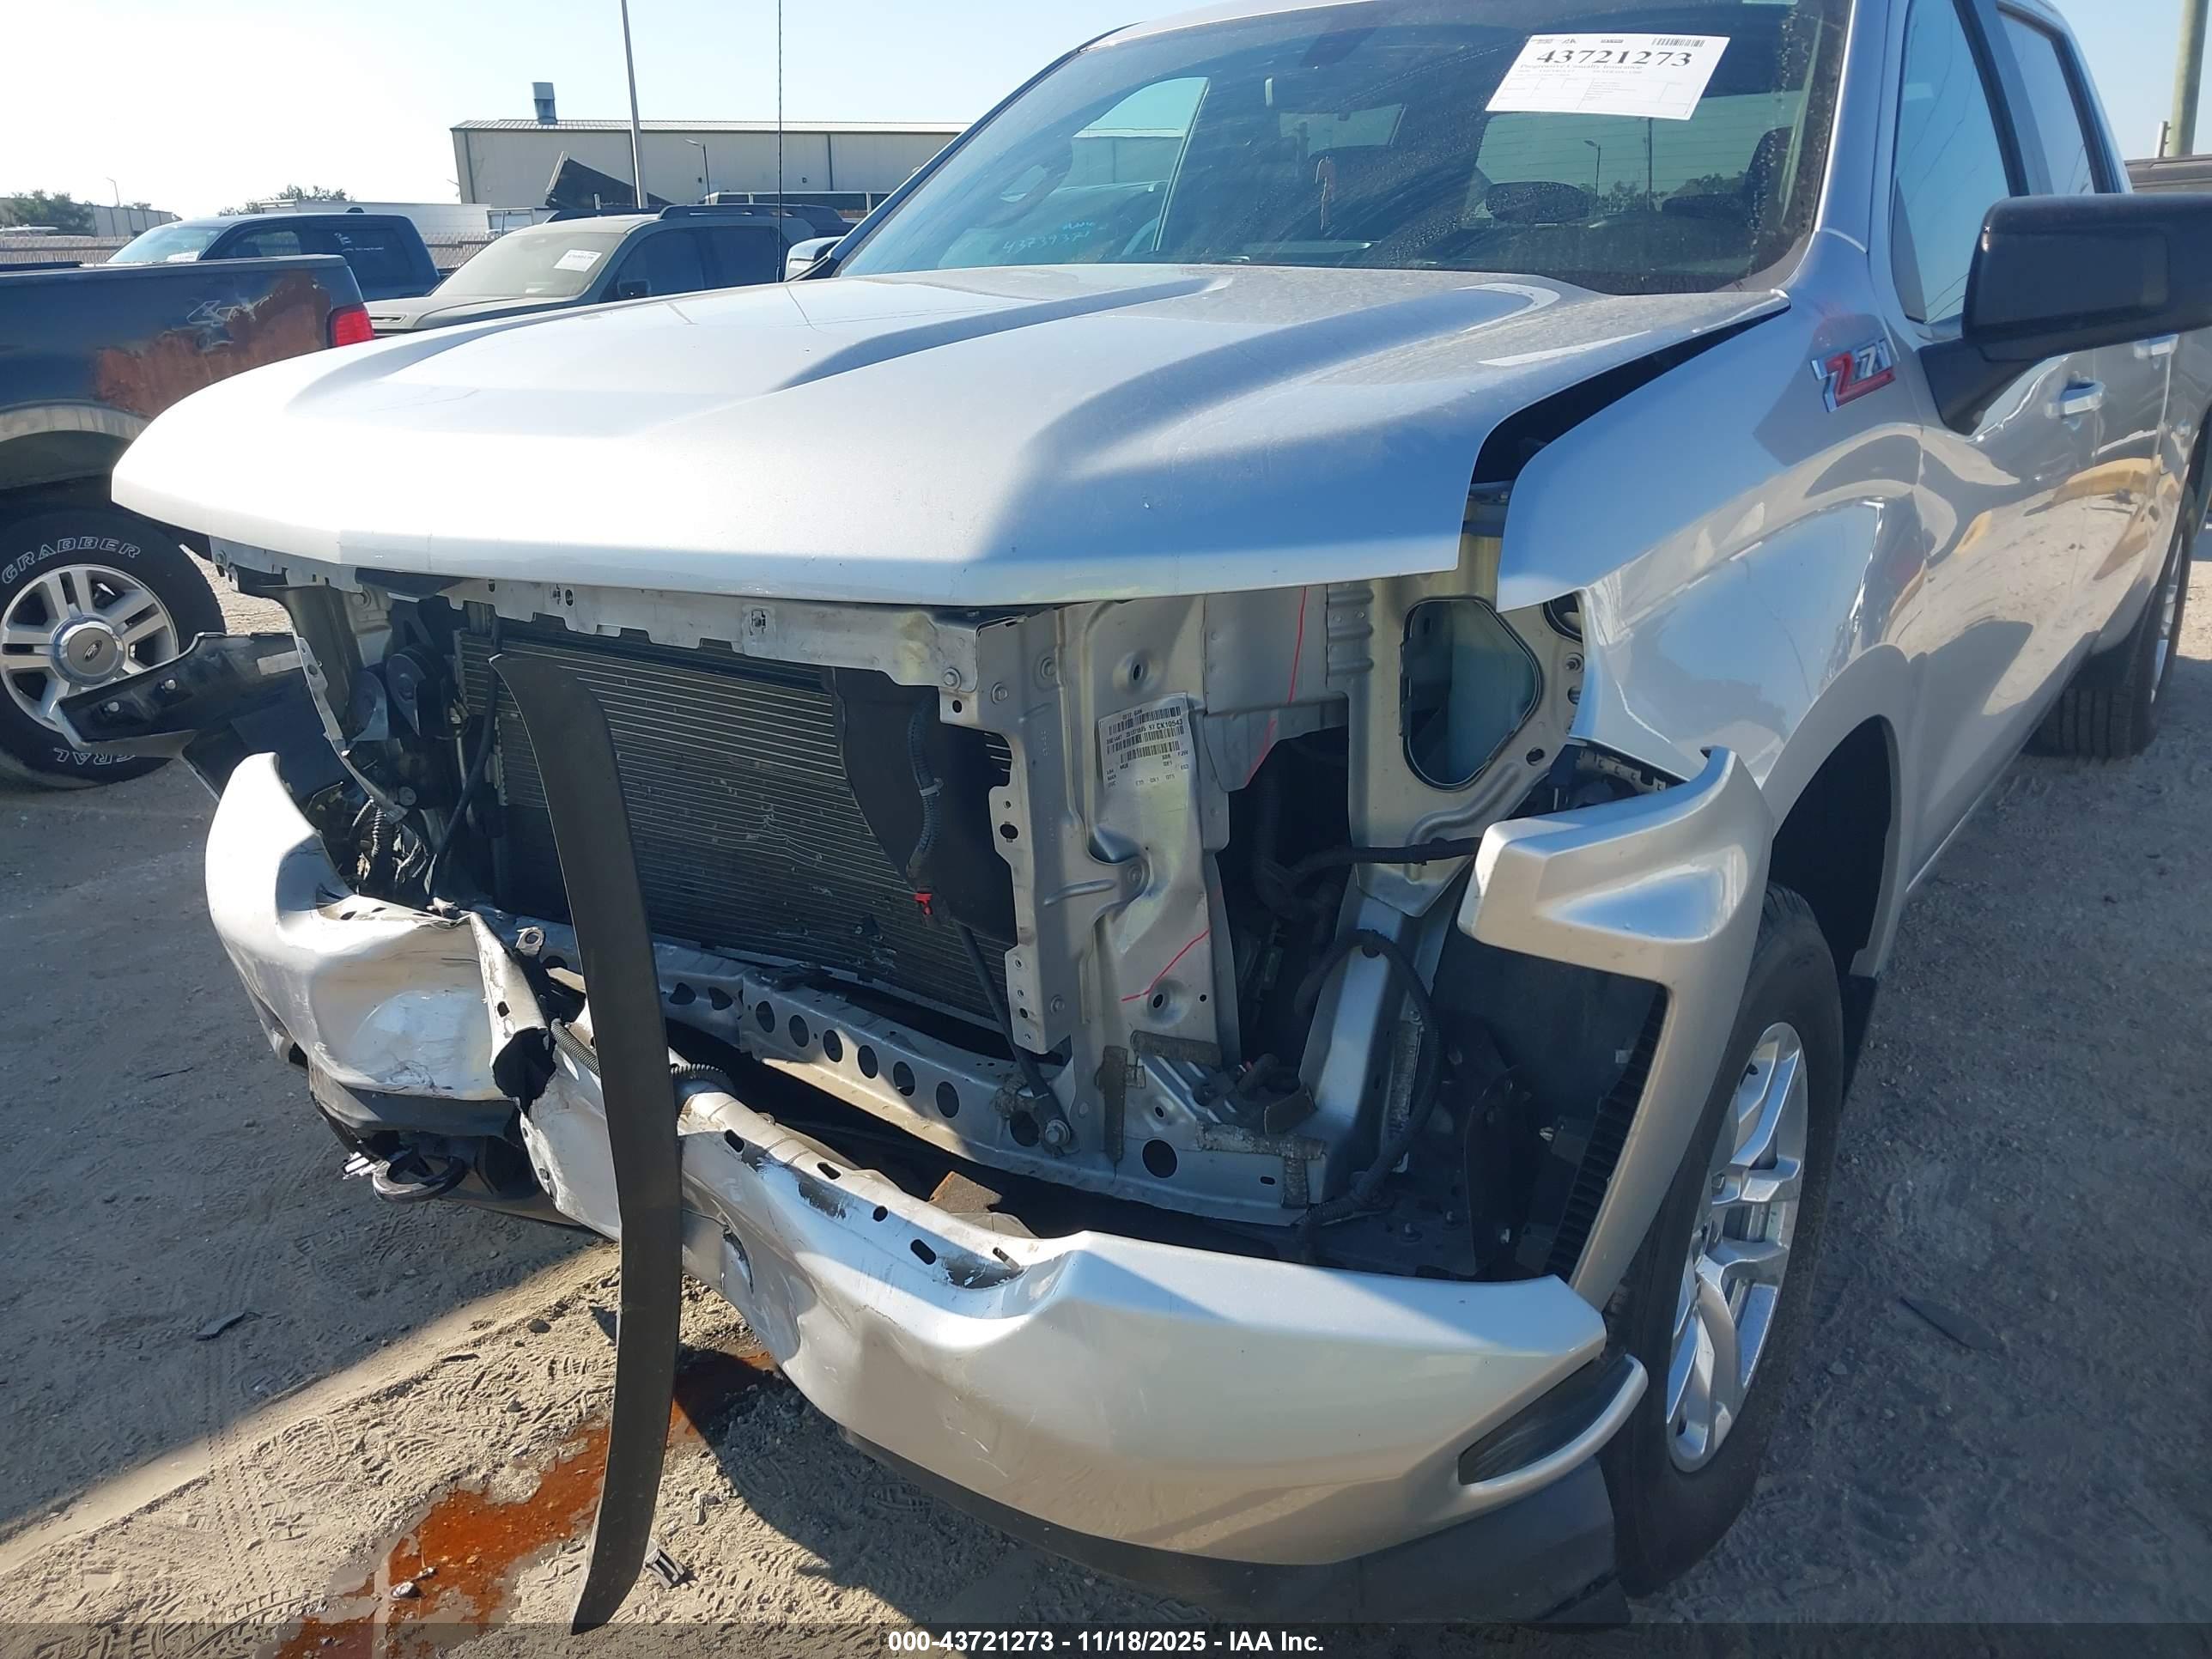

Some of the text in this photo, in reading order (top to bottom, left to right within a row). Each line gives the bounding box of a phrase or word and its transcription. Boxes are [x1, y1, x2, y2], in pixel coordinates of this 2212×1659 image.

[1537, 49, 1692, 67] 43721273
[1810, 338, 1896, 412] Z71
[1, 536, 141, 585] GRABBER
